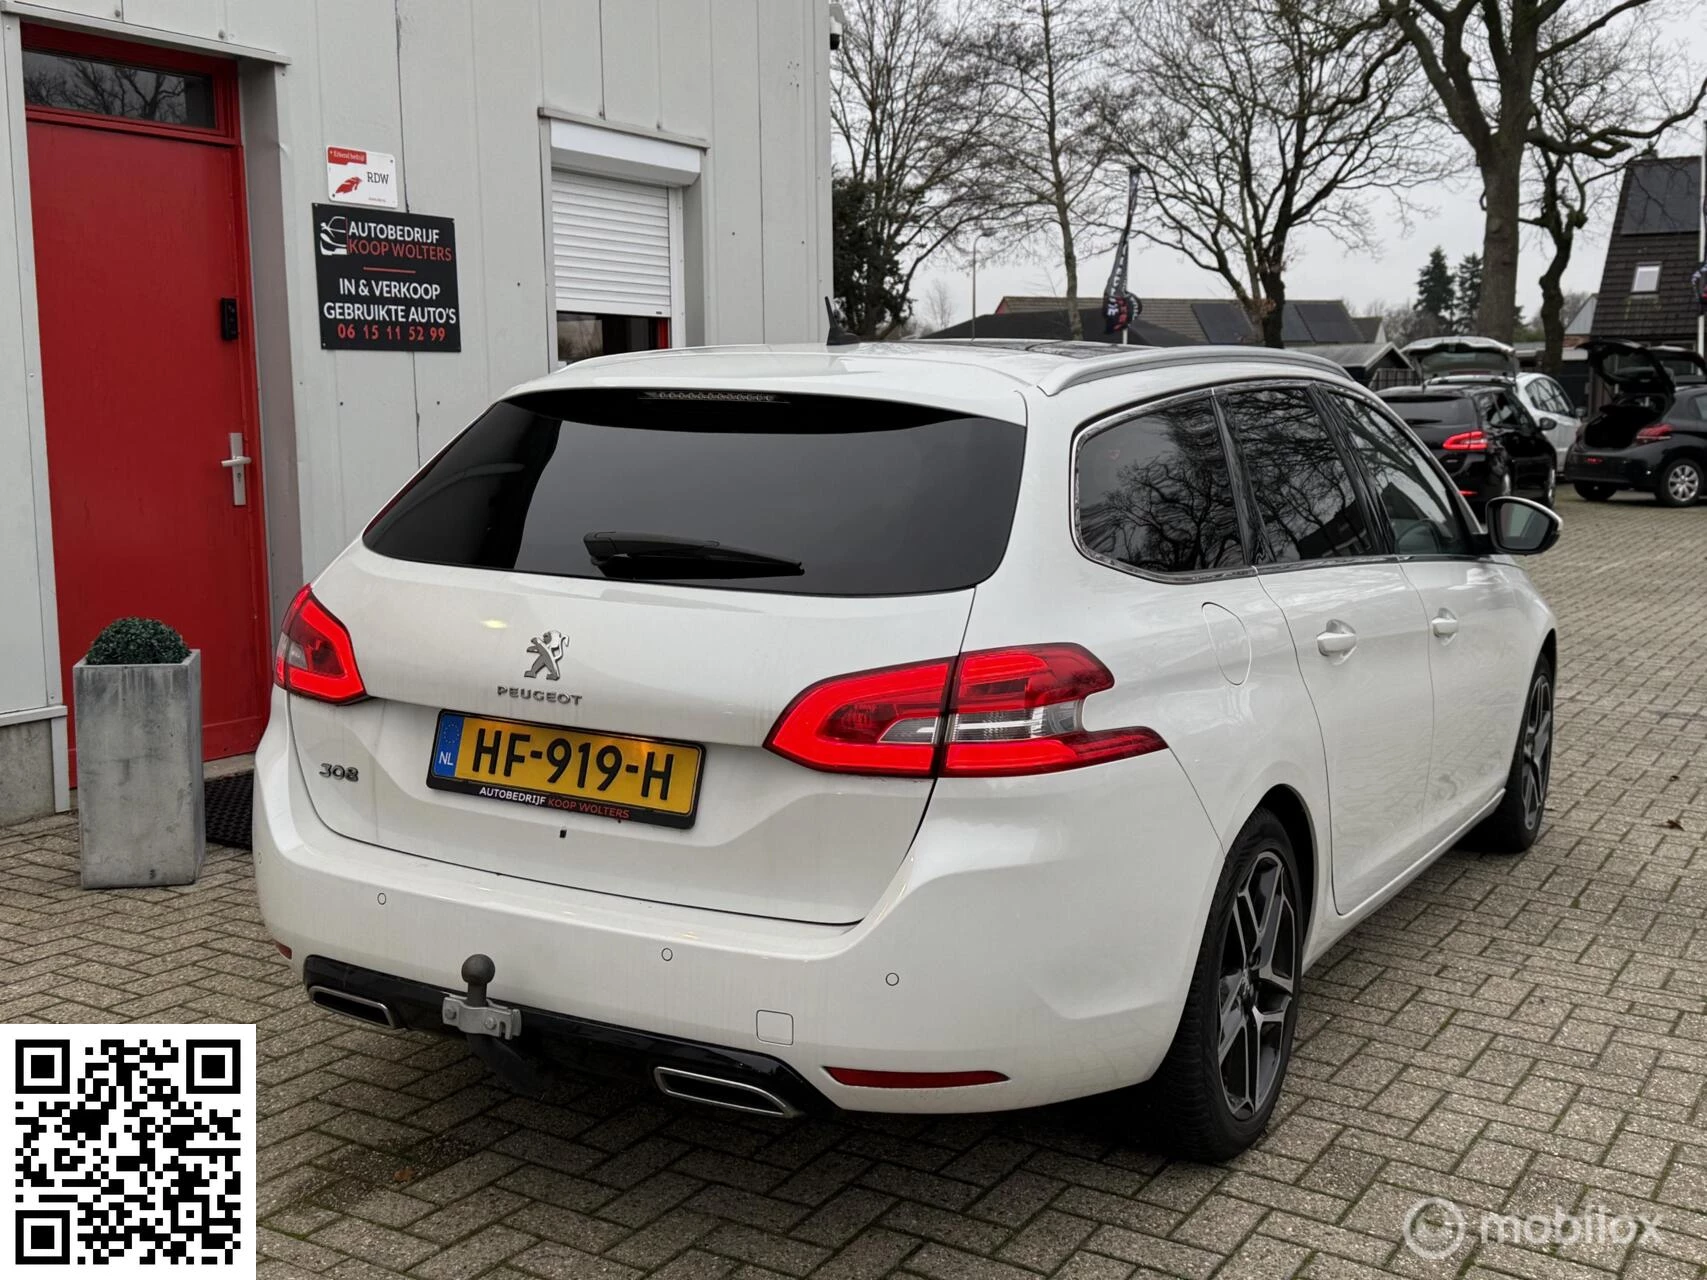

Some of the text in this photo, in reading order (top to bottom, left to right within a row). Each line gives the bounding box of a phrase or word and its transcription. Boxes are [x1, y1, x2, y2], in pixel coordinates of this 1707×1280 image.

[367, 171, 389, 184] RDW
[349, 221, 440, 243] AUTOBEDRIJF
[349, 239, 452, 262] KOOP WOLTERS
[339, 278, 441, 300] IN & VERKOOP
[323, 302, 456, 324] GEBRUIKTE AUTO'S
[337, 323, 446, 341] 06 15 11 52 99
[497, 685, 583, 706] PEUGEOT
[439, 751, 454, 767] NL
[472, 728, 674, 801] HF-919-H
[319, 762, 359, 782] 308
[479, 786, 630, 819] AUTOBEDRIJF KOOP WOLTERS
